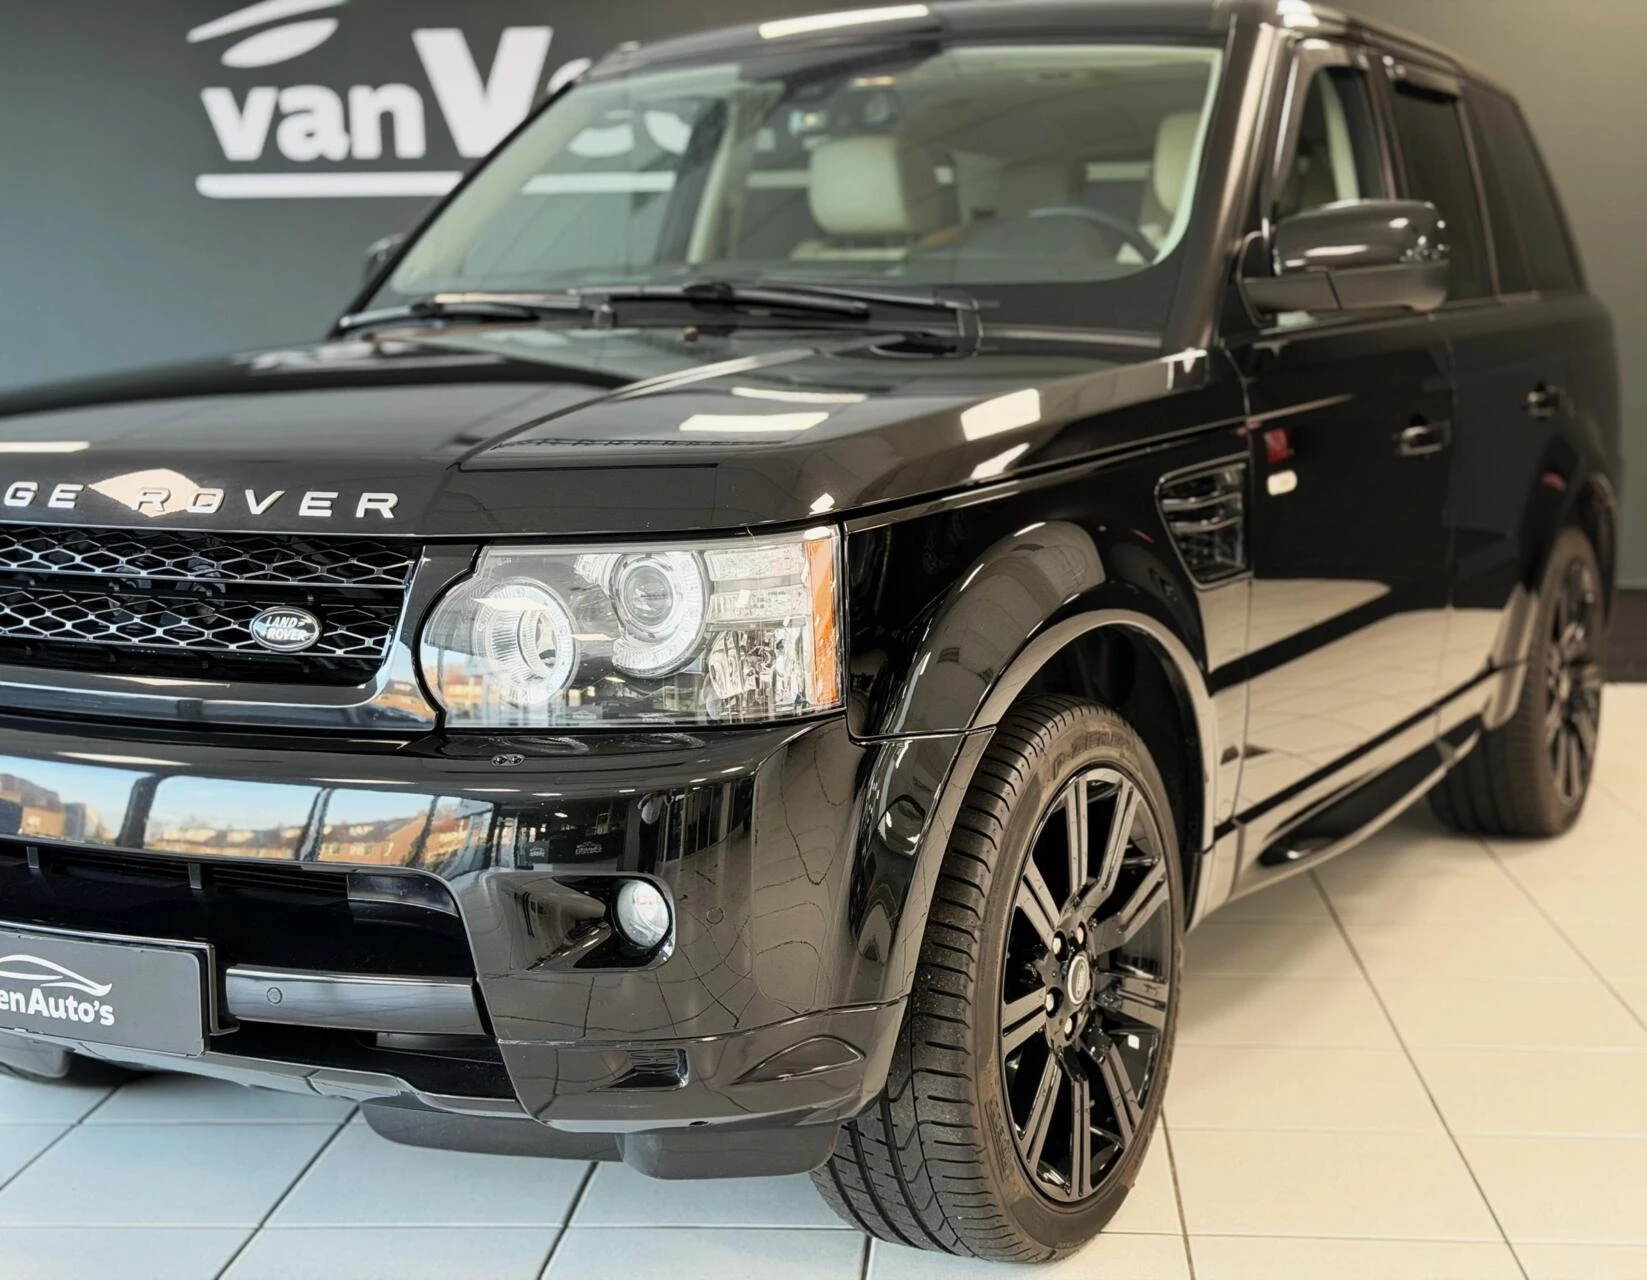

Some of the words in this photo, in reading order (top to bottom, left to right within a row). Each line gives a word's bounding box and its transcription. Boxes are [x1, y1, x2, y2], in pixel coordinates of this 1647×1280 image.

[136, 487, 399, 518] ROVER
[265, 616, 298, 628] LAND
[266, 628, 306, 641] ROVER
